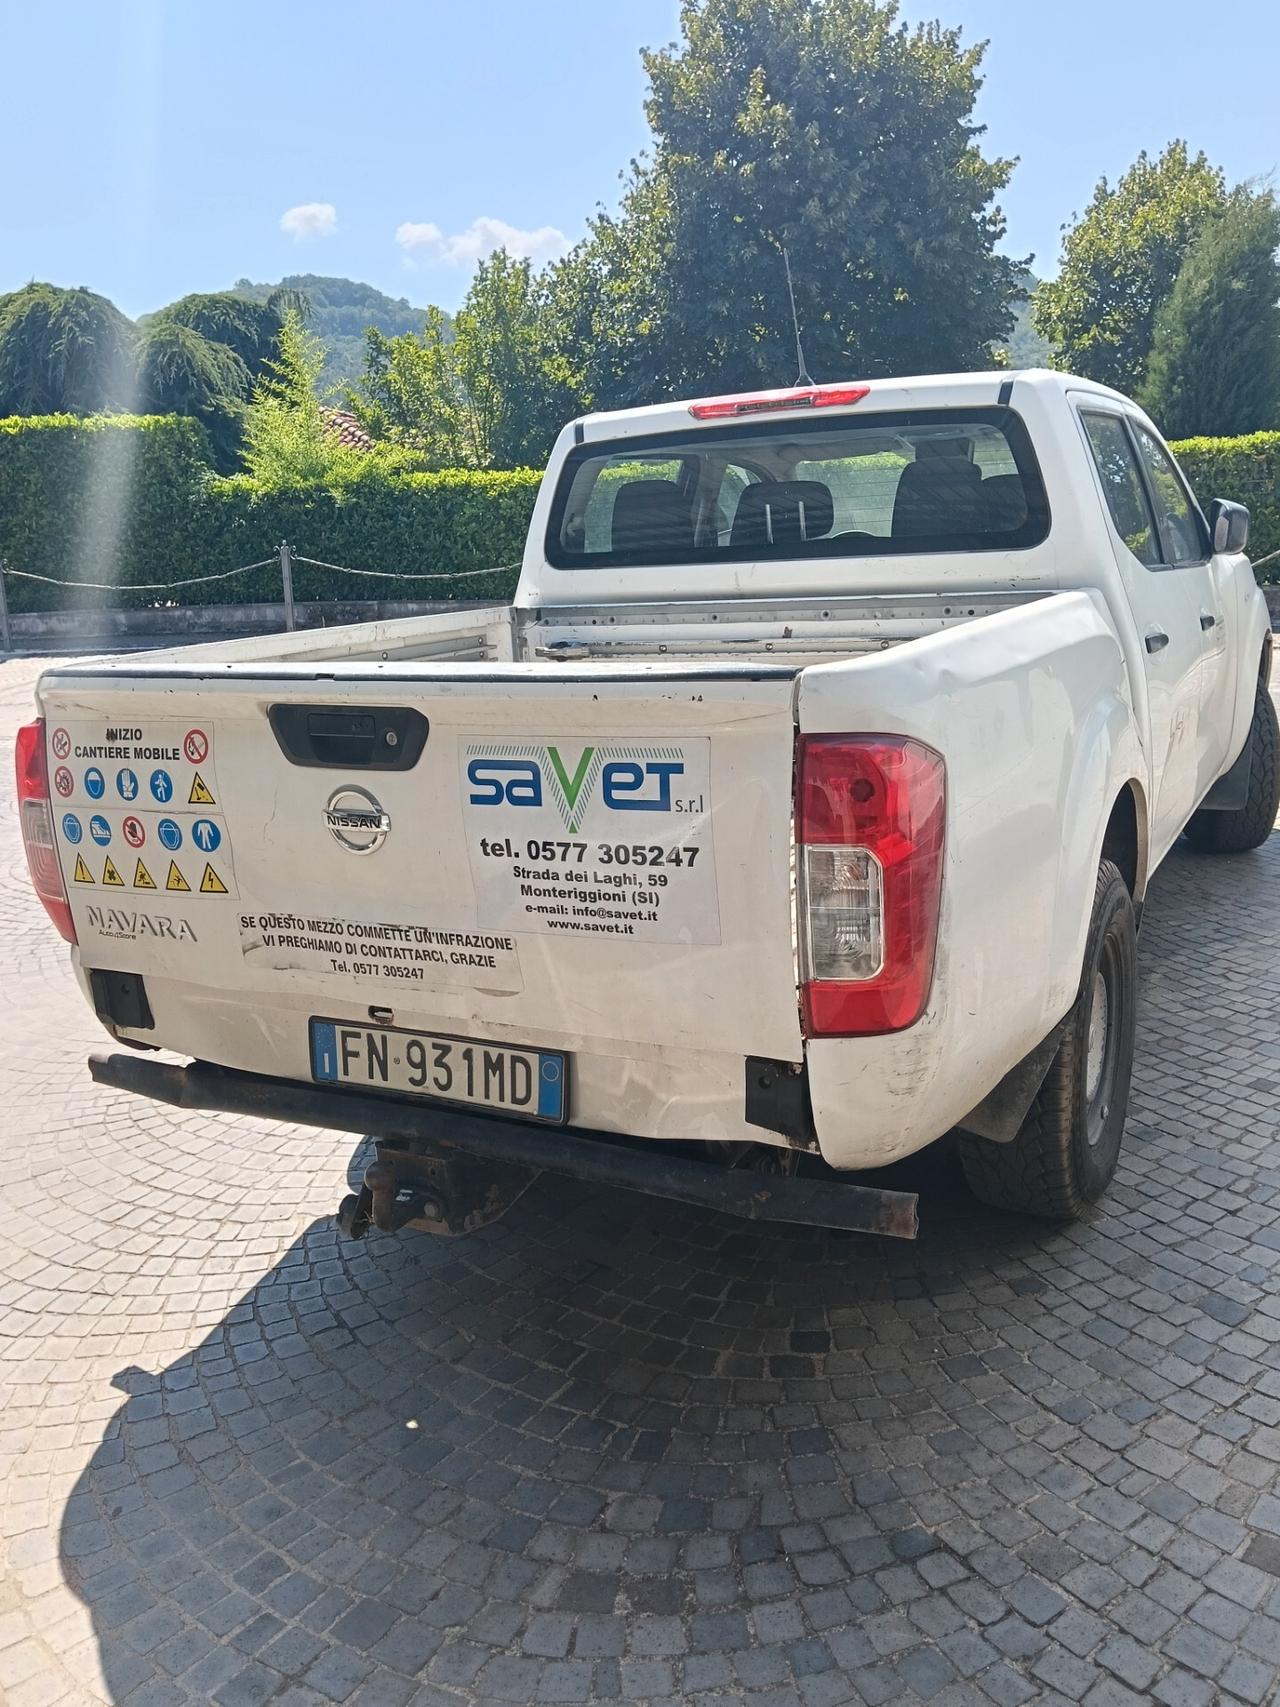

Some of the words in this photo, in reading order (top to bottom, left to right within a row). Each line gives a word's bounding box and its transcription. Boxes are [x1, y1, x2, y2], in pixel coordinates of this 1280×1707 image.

[106, 728, 143, 742] INIZIO
[74, 746, 131, 760] CANTIERE
[133, 747, 180, 761] MOBILE
[675, 794, 704, 814] s.r.l
[326, 814, 382, 829] NISSAN
[479, 837, 520, 859] tel.
[526, 839, 588, 863] 0577
[598, 843, 700, 868] 305247
[512, 865, 561, 882] Strada
[564, 870, 589, 884] dei
[593, 871, 643, 890] Laghi,
[647, 874, 669, 888] 59
[520, 884, 627, 904] Monteriggioni
[632, 890, 661, 908] (SI)
[525, 903, 569, 916] e-mail:
[572, 905, 659, 922] info@savet.it
[85, 905, 198, 943] NAVARA
[240, 916, 257, 929] SE
[259, 915, 305, 931] QUESTO
[307, 919, 344, 936] MEZZO
[346, 924, 412, 942] COMMETTE
[414, 930, 513, 951] UN'INFRAZIONE
[547, 919, 635, 935] www.savet.it
[262, 934, 275, 948] VI
[278, 936, 342, 954] PREGHIAMO
[345, 943, 358, 955] DI
[360, 944, 448, 965] CONTATTARCI,
[450, 952, 497, 968] GRAZIE
[331, 959, 351, 973] Tel.
[353, 962, 379, 977] 0577
[383, 965, 425, 980] 305247
[340, 1029, 389, 1082] FN
